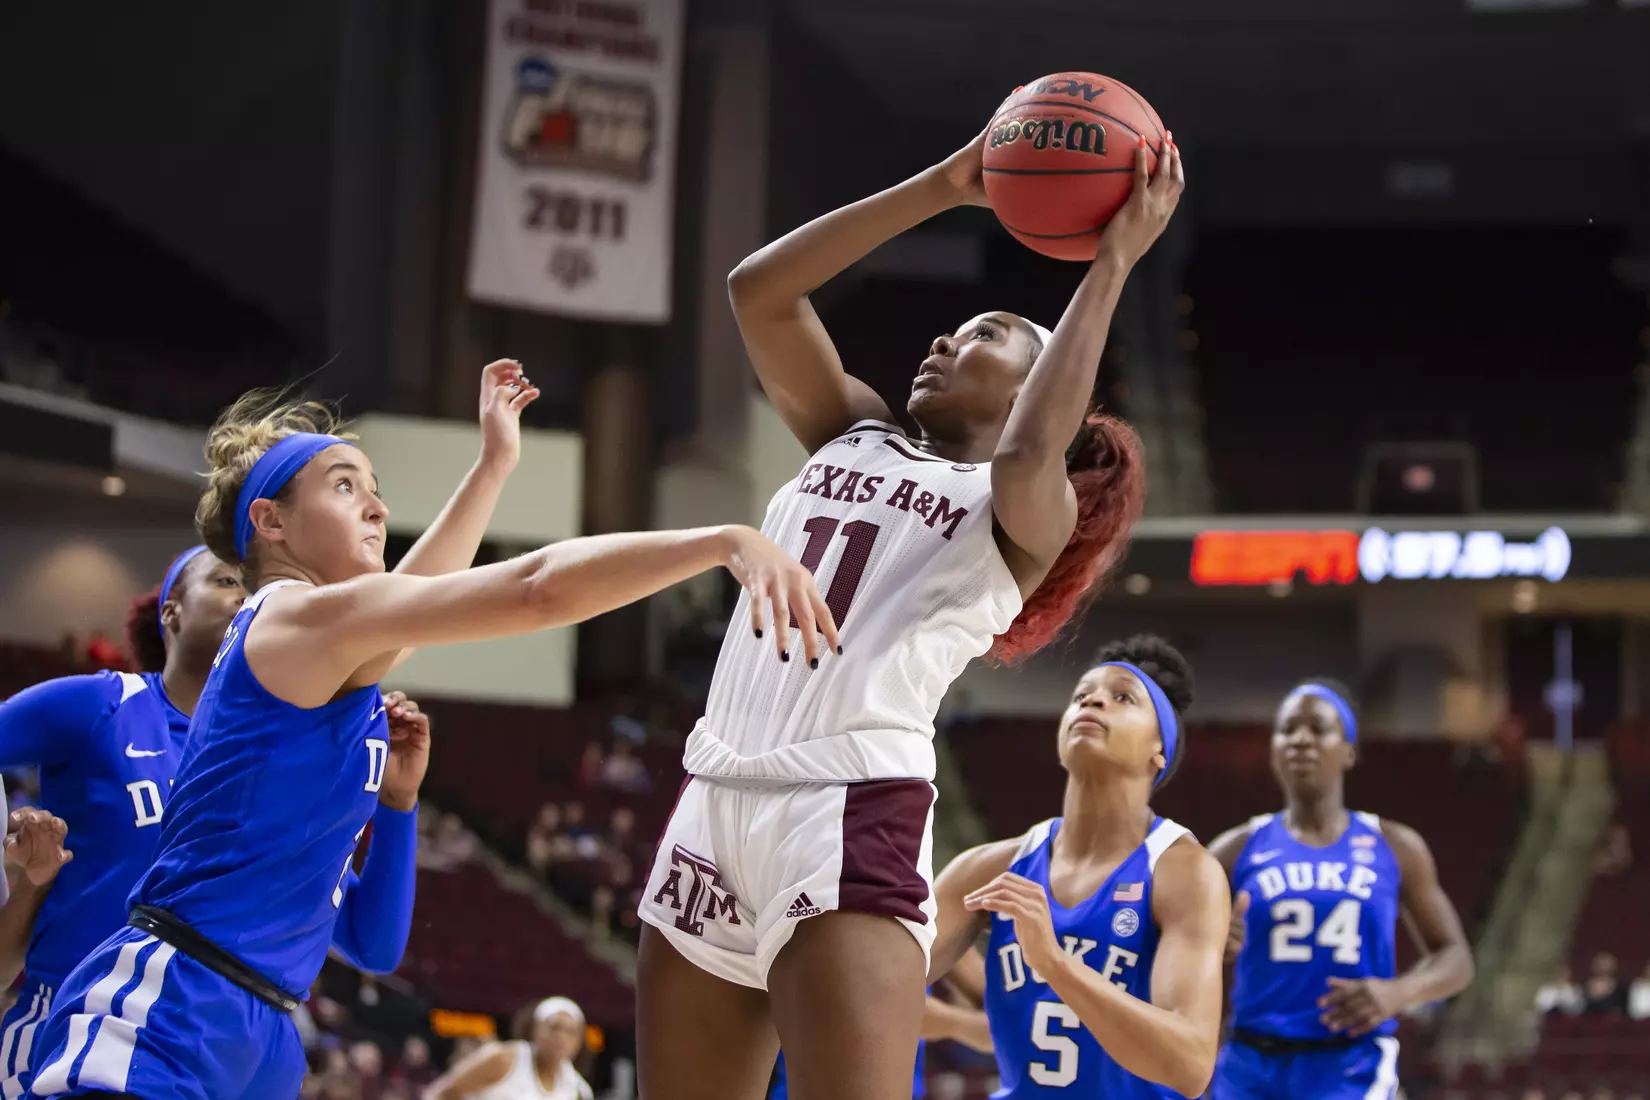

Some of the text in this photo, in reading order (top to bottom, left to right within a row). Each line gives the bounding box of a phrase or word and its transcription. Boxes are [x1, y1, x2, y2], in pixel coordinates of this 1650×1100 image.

[991, 118, 1107, 157] Wilson
[523, 186, 628, 240] 2011
[797, 464, 969, 541] EXAS A&M
[776, 516, 880, 633] 11
[1256, 861, 1378, 900] DUKE
[786, 905, 821, 918] adidas
[1269, 898, 1362, 965] 24
[998, 935, 1139, 993] DKE
[1028, 1000, 1081, 1088] 5
